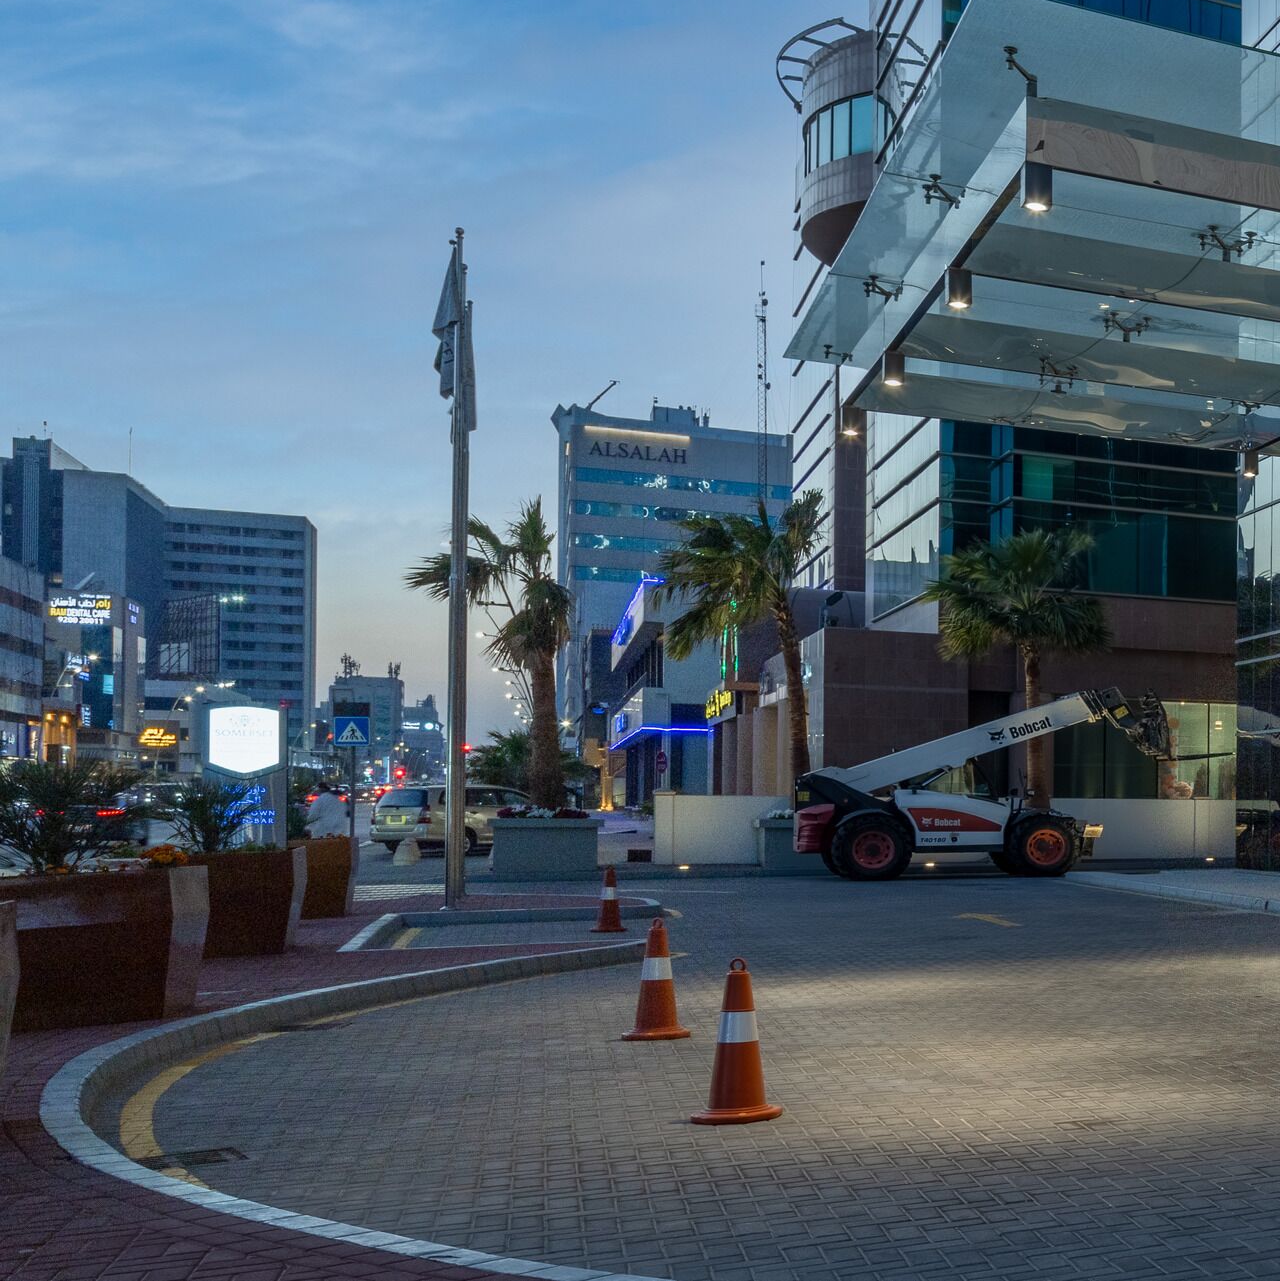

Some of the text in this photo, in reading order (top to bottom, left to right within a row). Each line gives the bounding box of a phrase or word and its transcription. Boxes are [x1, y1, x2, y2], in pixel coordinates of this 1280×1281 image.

[589, 441, 687, 464] ALSALAH
[92, 609, 111, 619] CARE
[1009, 716, 1053, 739] Bobcat
[934, 818, 961, 828] Bobcat
